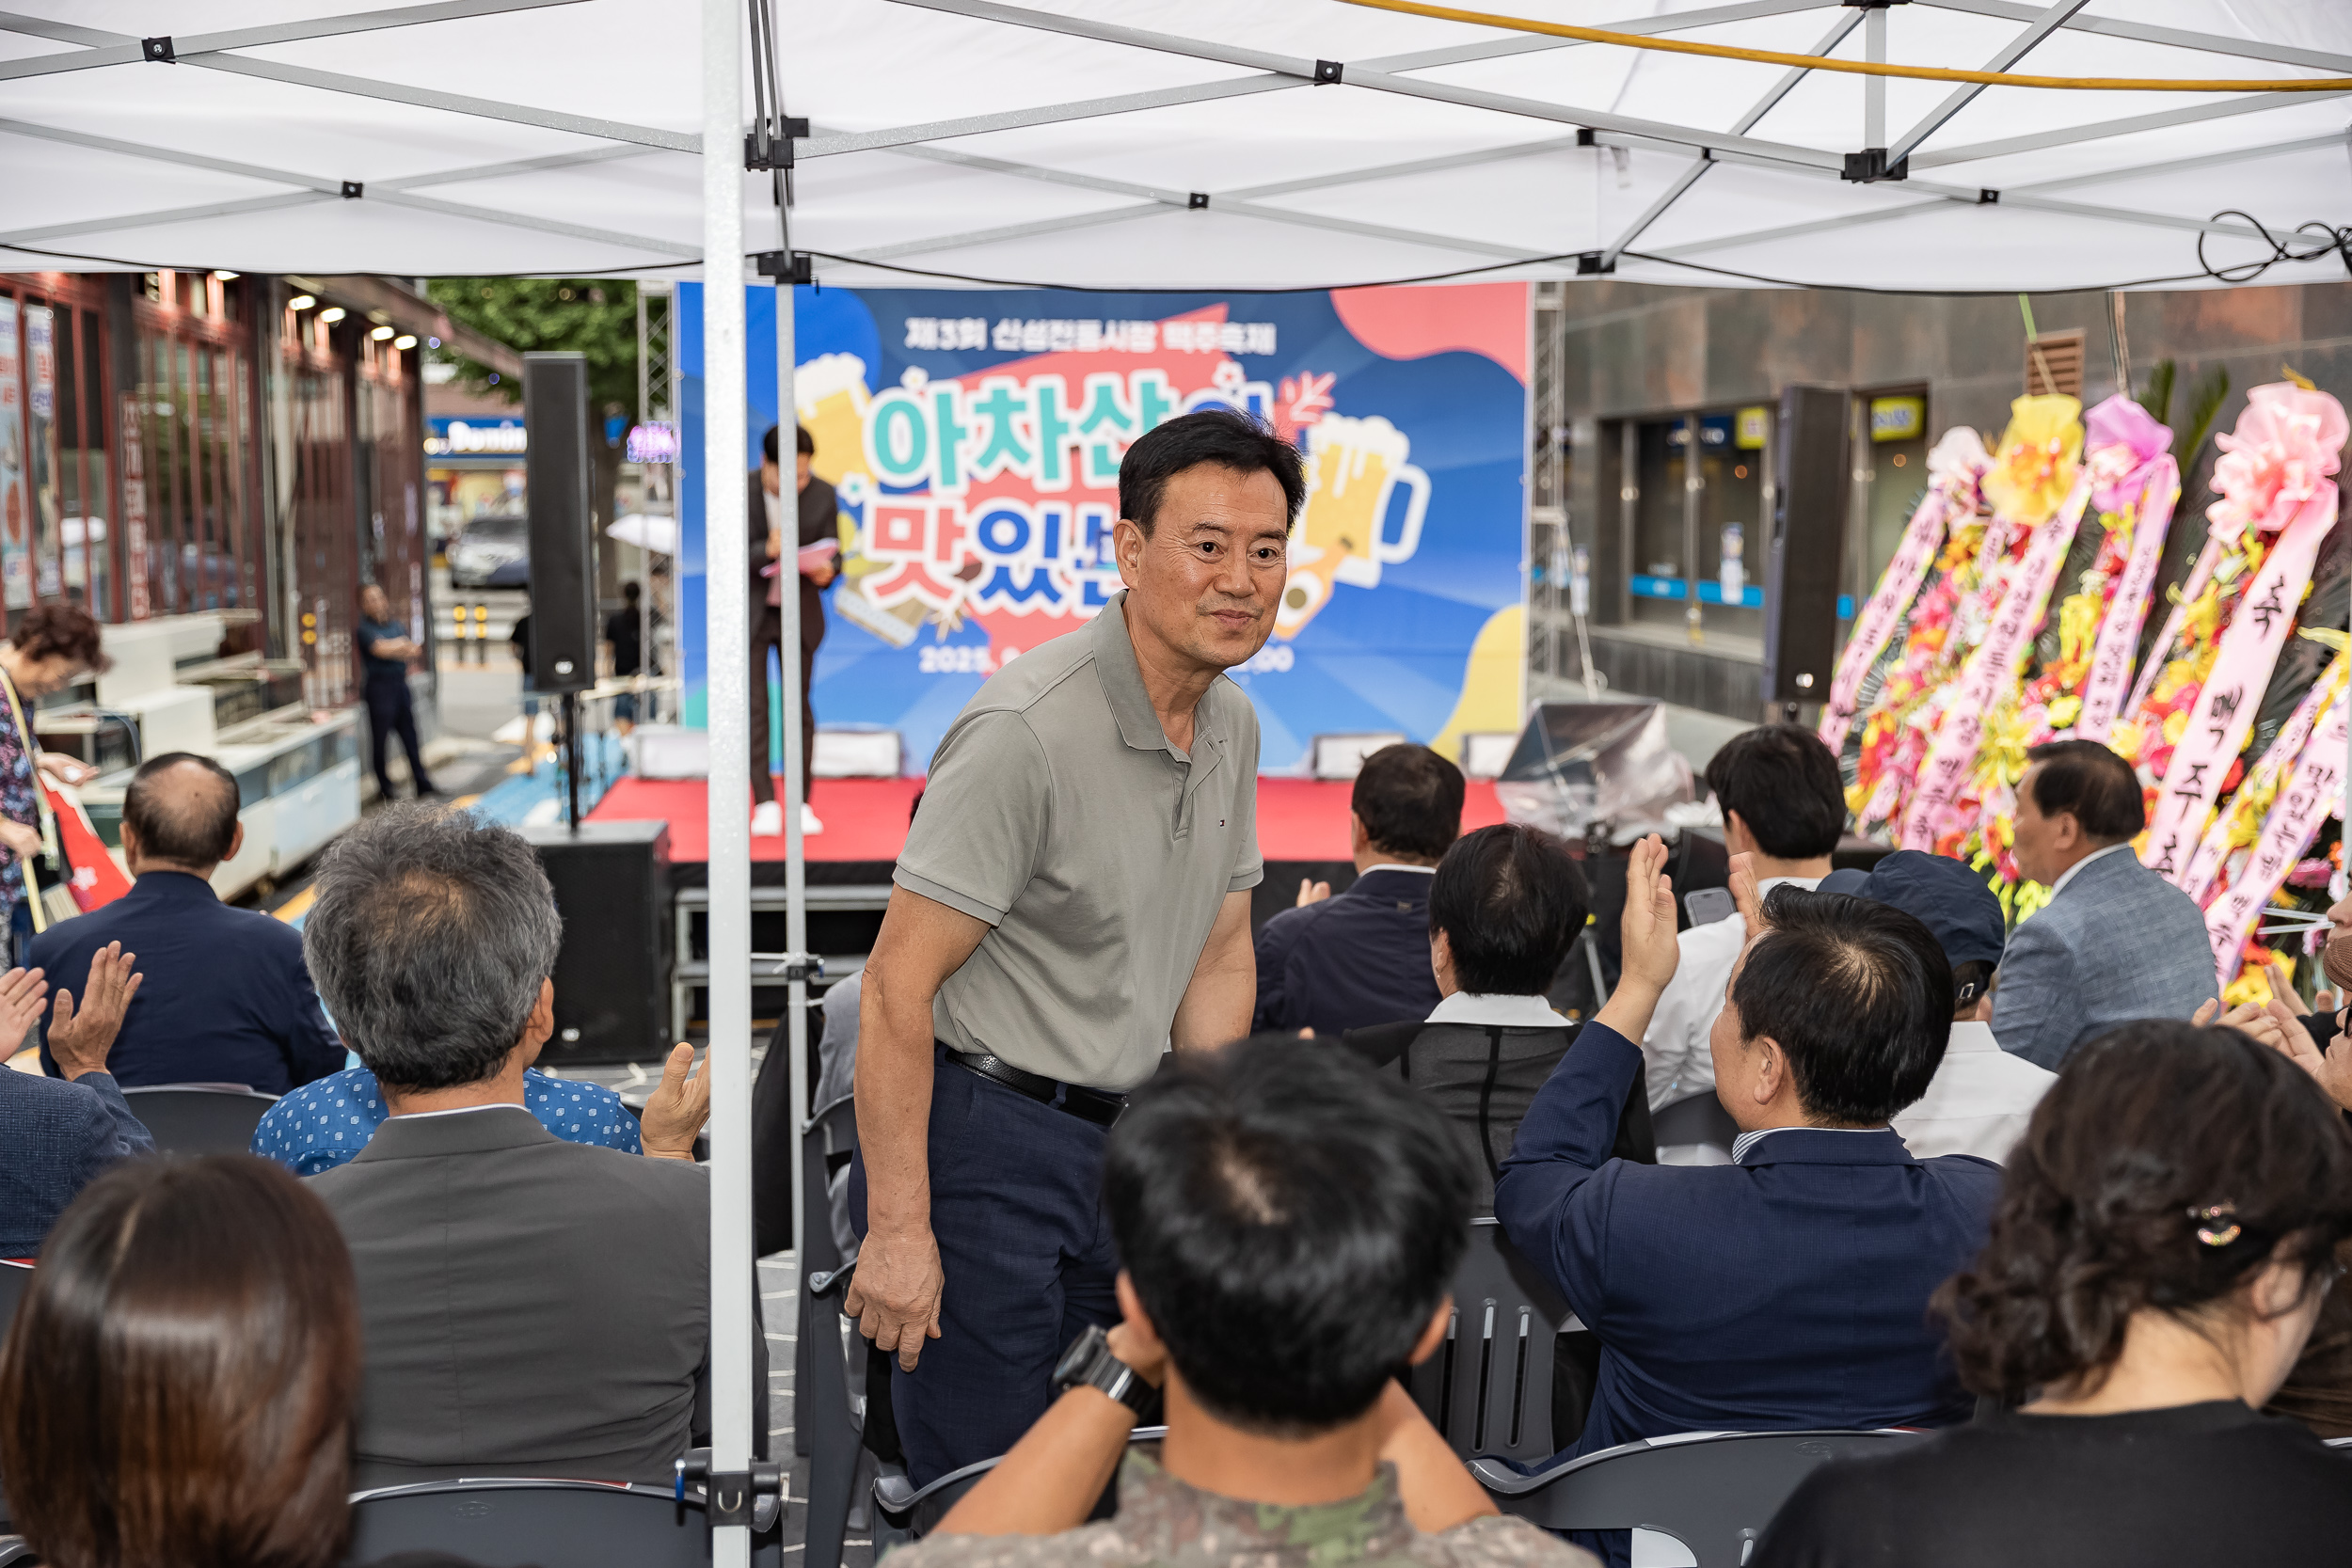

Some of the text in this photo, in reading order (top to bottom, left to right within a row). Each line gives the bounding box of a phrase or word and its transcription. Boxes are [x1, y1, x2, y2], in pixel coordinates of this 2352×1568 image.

[904, 317, 988, 351] 제3회
[1162, 321, 1278, 356] 맥주축제
[865, 370, 1272, 491] 아차산
